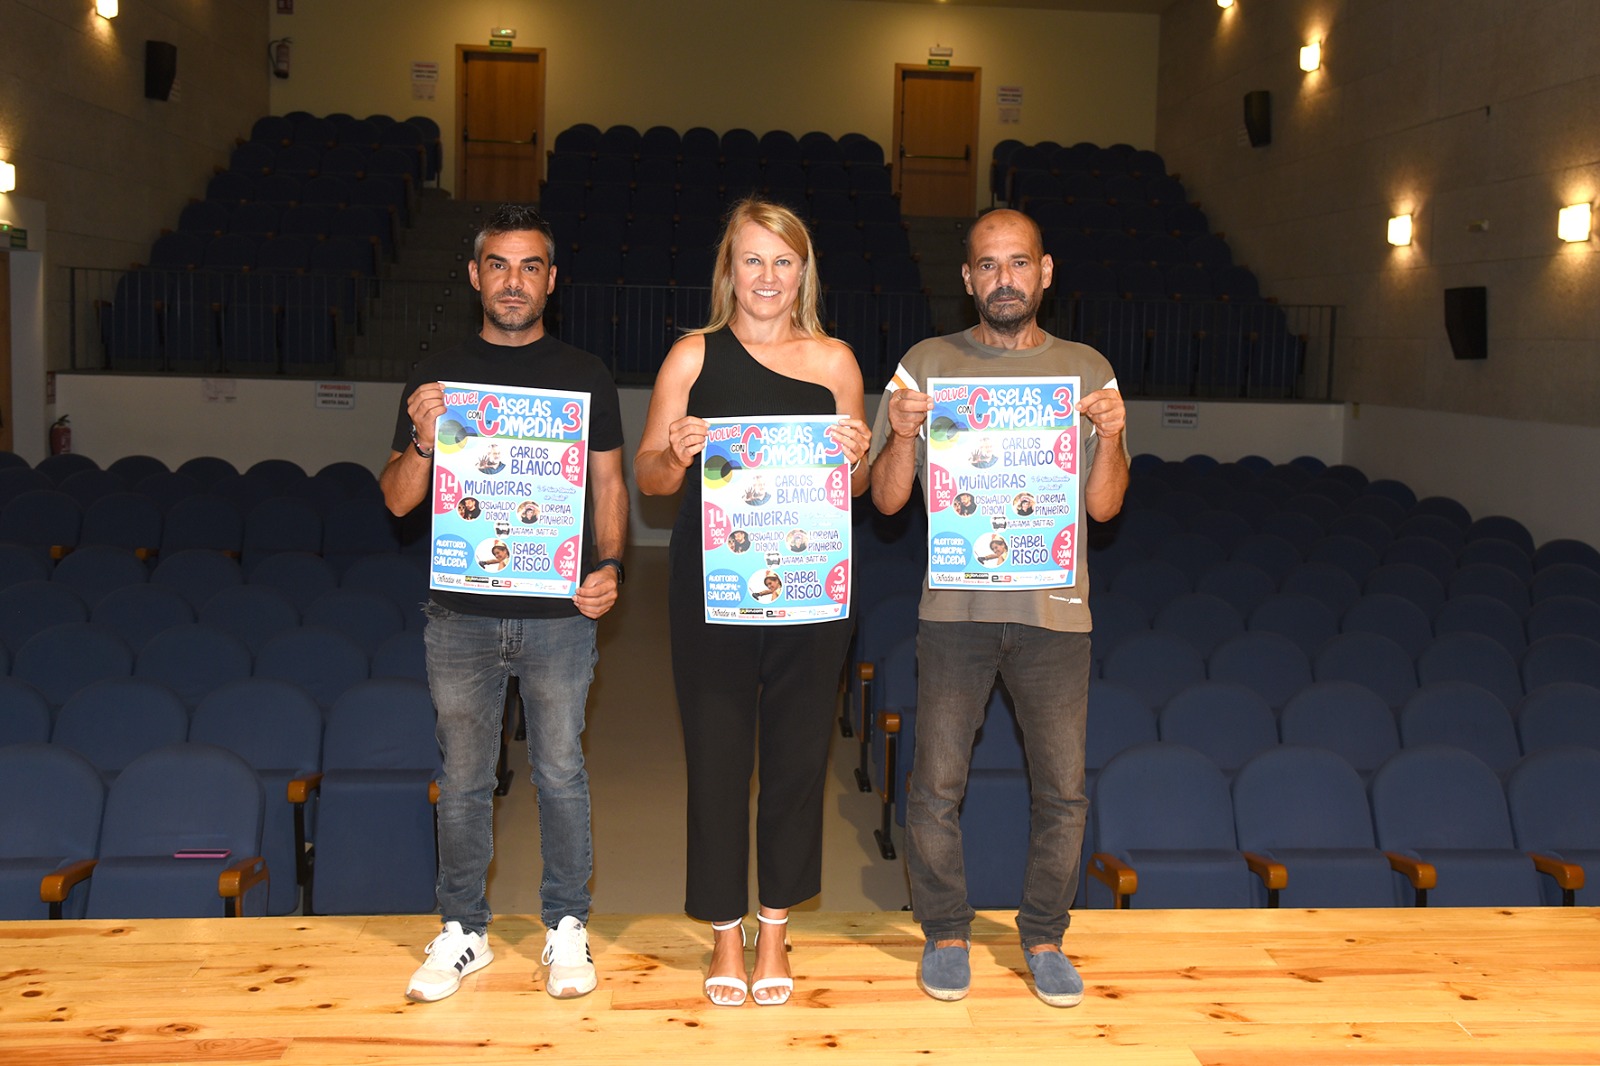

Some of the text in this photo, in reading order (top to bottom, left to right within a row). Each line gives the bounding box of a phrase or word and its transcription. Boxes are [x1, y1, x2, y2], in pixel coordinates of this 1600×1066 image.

[1053, 387, 1072, 418] 3
[468, 411, 481, 420] CON
[958, 405, 971, 414] CON
[563, 402, 582, 432] 3
[731, 444, 745, 453] CON
[1002, 437, 1040, 450] CARLOS
[1060, 433, 1071, 451] 8
[510, 446, 548, 459] CARLOS
[568, 447, 579, 464] 8
[1004, 450, 1053, 467] BLANCO
[1058, 452, 1073, 461] NOV
[511, 460, 561, 476] BLANCO
[566, 465, 580, 474] NOV
[440, 473, 458, 493] 14
[775, 475, 813, 487] CARLOS
[832, 471, 843, 488] 8
[934, 470, 953, 489] 14
[777, 488, 826, 504] BLANCO
[831, 489, 845, 498] NOV
[976, 495, 1011, 505] OSWALDO
[480, 501, 516, 511] OSWALDO
[708, 508, 726, 528] 14
[750, 531, 784, 541] OSWALDO
[1010, 535, 1045, 548] ISABEL
[1060, 530, 1071, 550] 3
[513, 542, 547, 556] ISABEL
[563, 542, 575, 560] 3
[1057, 550, 1071, 558] XAN
[434, 556, 468, 568] SALCEDA
[932, 554, 966, 565] SALCEDA
[1012, 549, 1048, 564] RISCO
[514, 556, 550, 572] RISCO
[559, 560, 575, 569] XAN
[784, 571, 818, 584] ISABEL
[833, 566, 845, 584] 3
[786, 584, 822, 600] RISCO
[831, 585, 845, 593] XAN
[708, 591, 741, 602] SALCEDA
